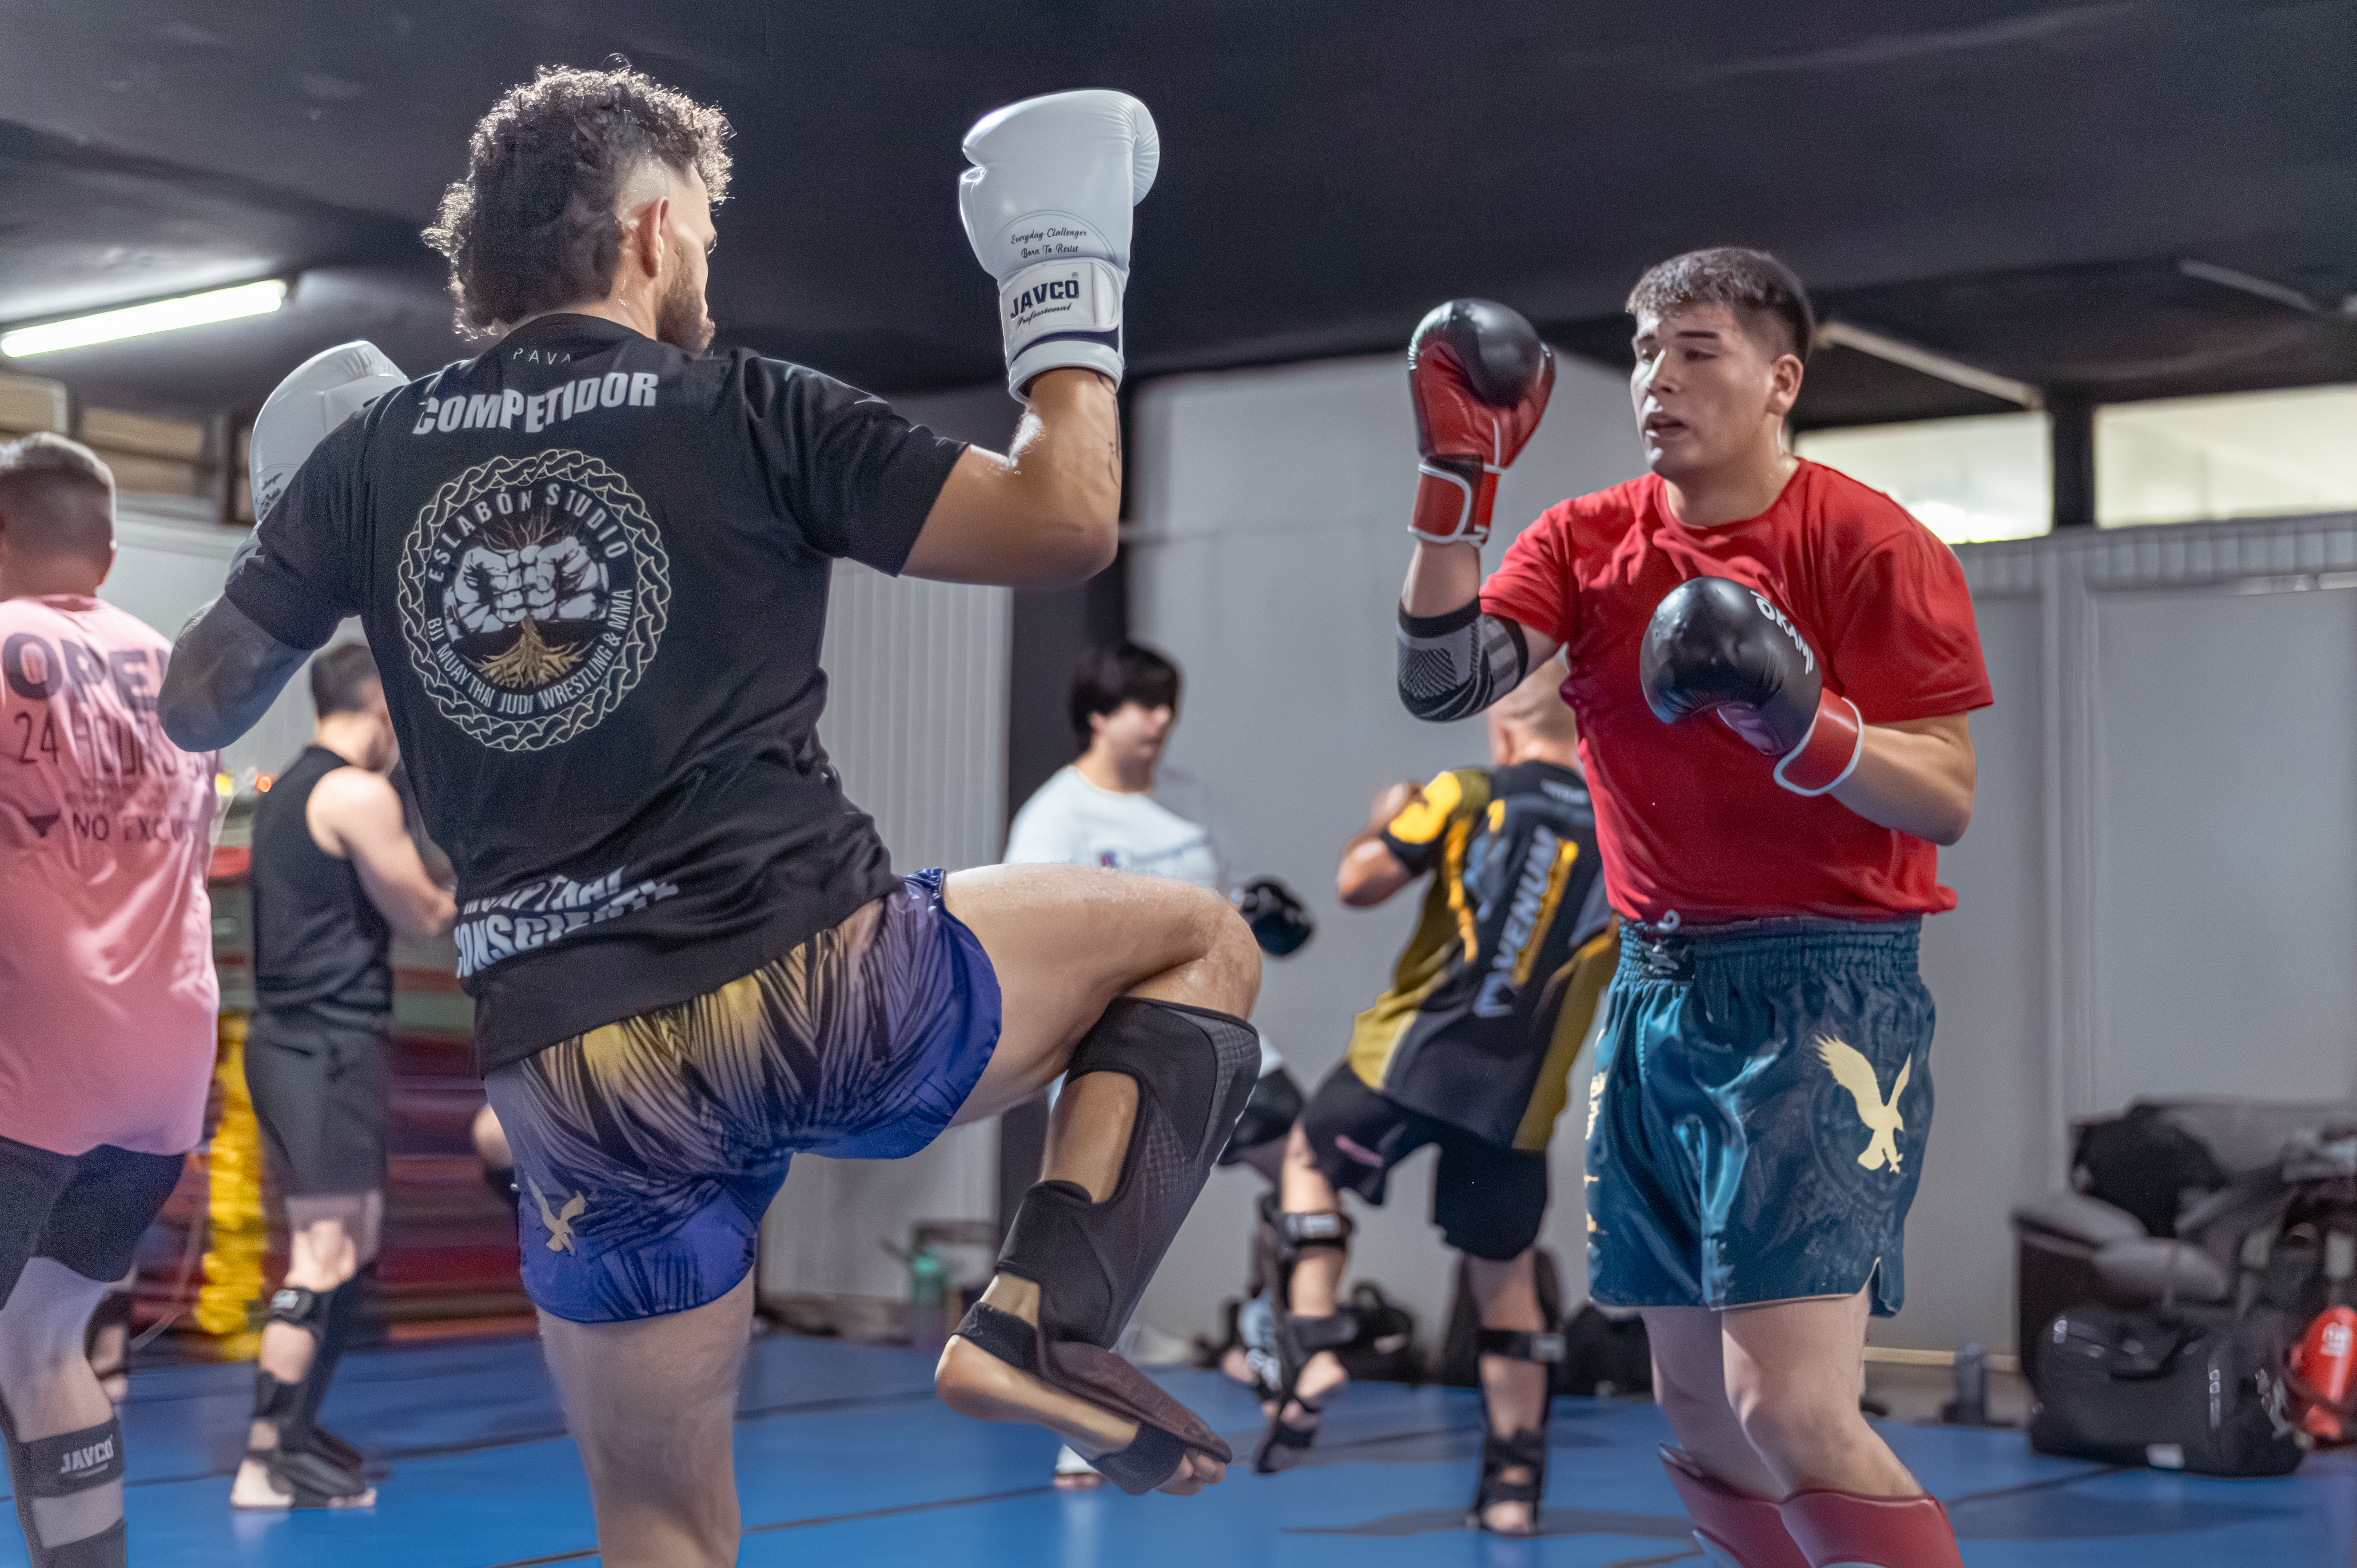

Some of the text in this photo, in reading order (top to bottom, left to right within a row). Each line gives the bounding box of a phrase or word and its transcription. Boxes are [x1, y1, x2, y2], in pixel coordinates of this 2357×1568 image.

[1011, 229, 1043, 244] Everyday
[1043, 245, 1052, 255] To
[1010, 280, 1079, 320] JAVCO
[412, 372, 659, 434] COMPETIDOR
[428, 483, 628, 582] ESLABÓN STUDIO
[437, 643, 472, 685] MUAY
[537, 645, 613, 710] WRESTLING
[608, 589, 633, 629] MMA
[13, 709, 59, 765] 24
[73, 812, 110, 840] NO
[61, 1440, 115, 1473] JAVCO
